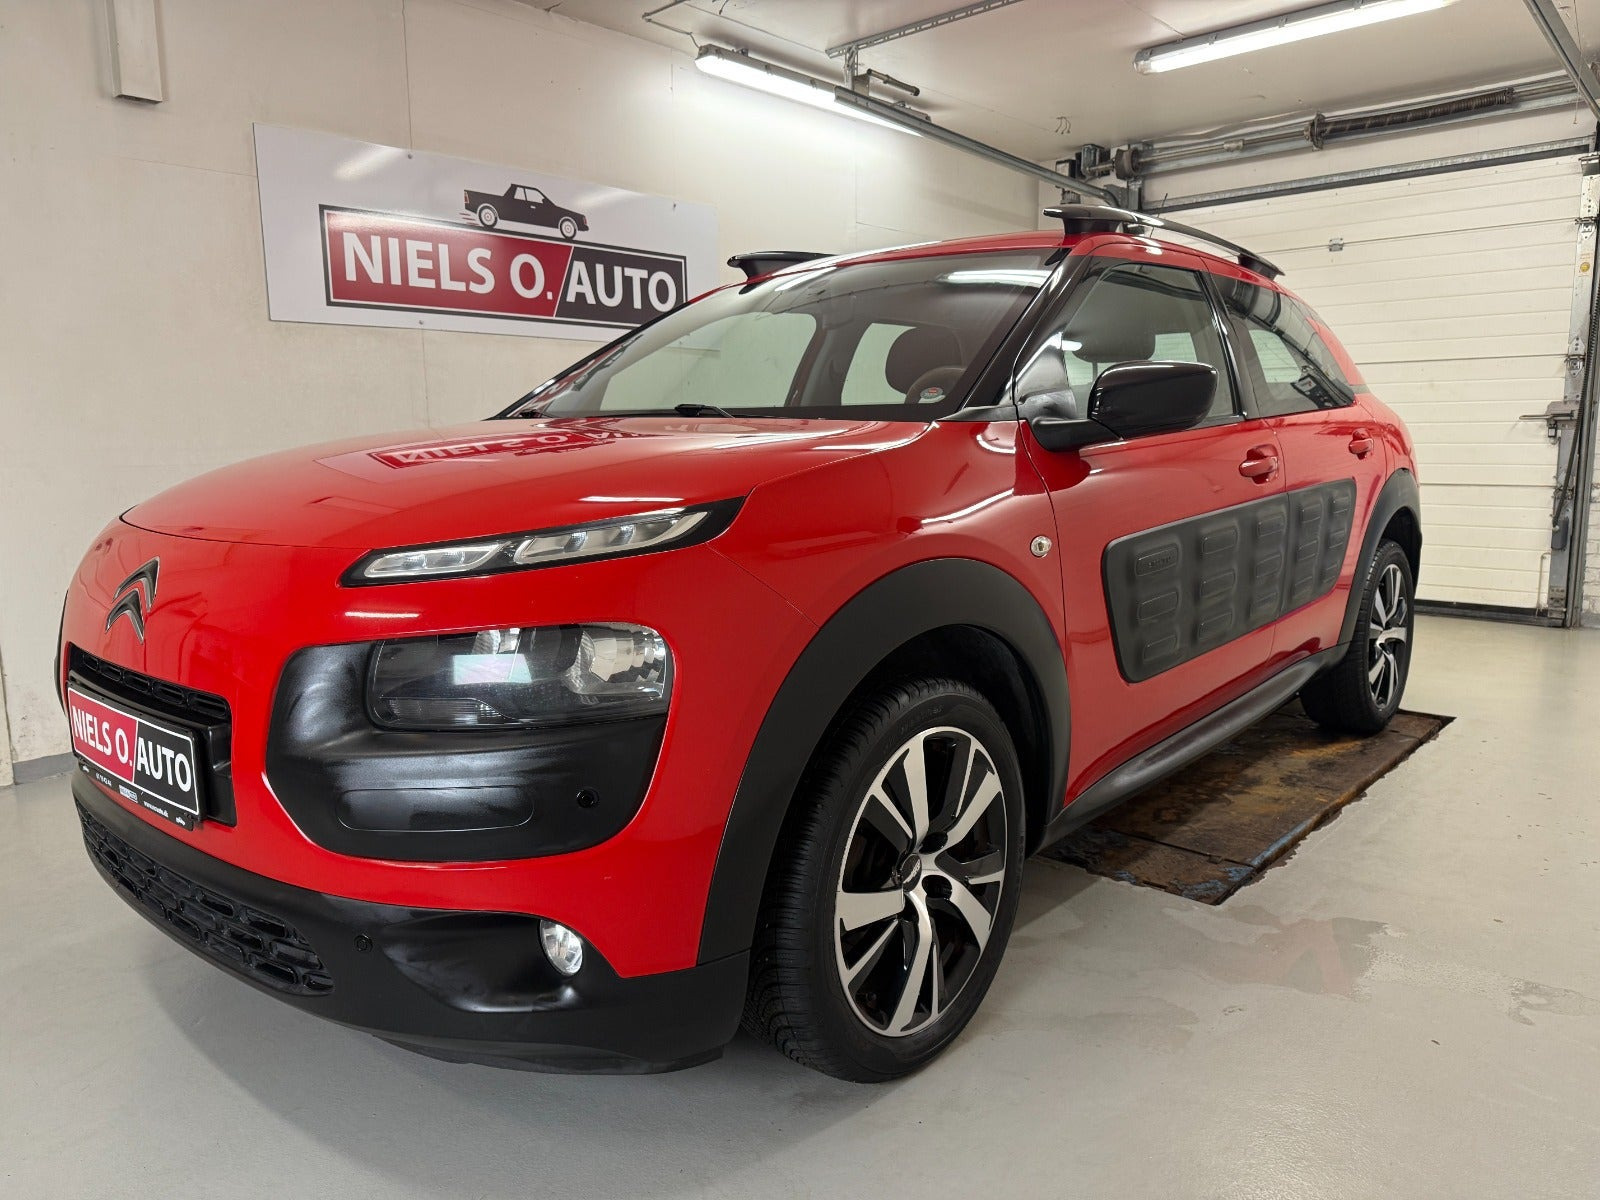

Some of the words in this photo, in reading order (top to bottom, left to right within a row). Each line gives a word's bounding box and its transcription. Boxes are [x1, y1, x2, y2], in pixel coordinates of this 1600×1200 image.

[342, 231, 496, 295] NIELS
[509, 252, 554, 300] O.
[565, 260, 677, 312] AUTO
[72, 705, 112, 756] NIELS
[115, 727, 133, 767] O.
[136, 736, 192, 792] AUTO
